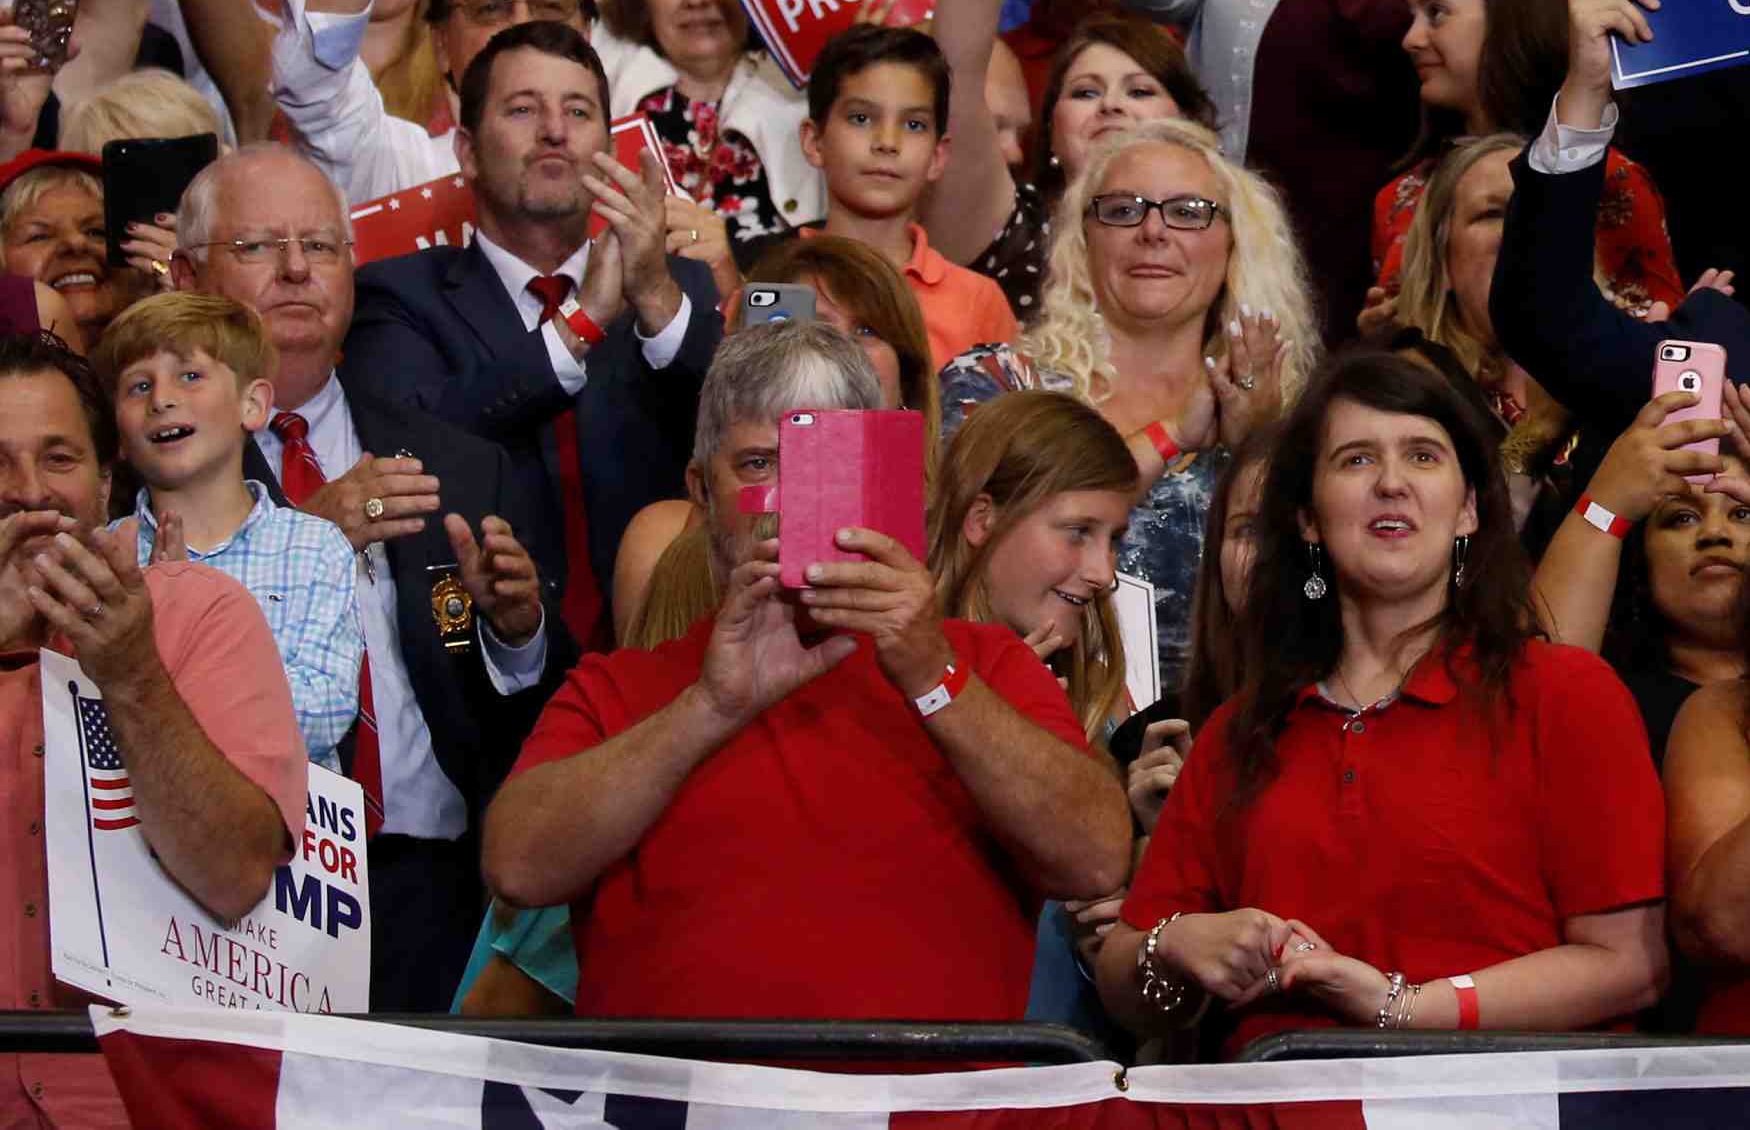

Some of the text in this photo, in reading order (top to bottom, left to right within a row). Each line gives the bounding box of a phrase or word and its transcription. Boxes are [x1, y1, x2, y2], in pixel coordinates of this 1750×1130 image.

[302, 829, 358, 885] FOR
[160, 915, 333, 1014] AMERICA
[191, 975, 249, 1010] GREAT
